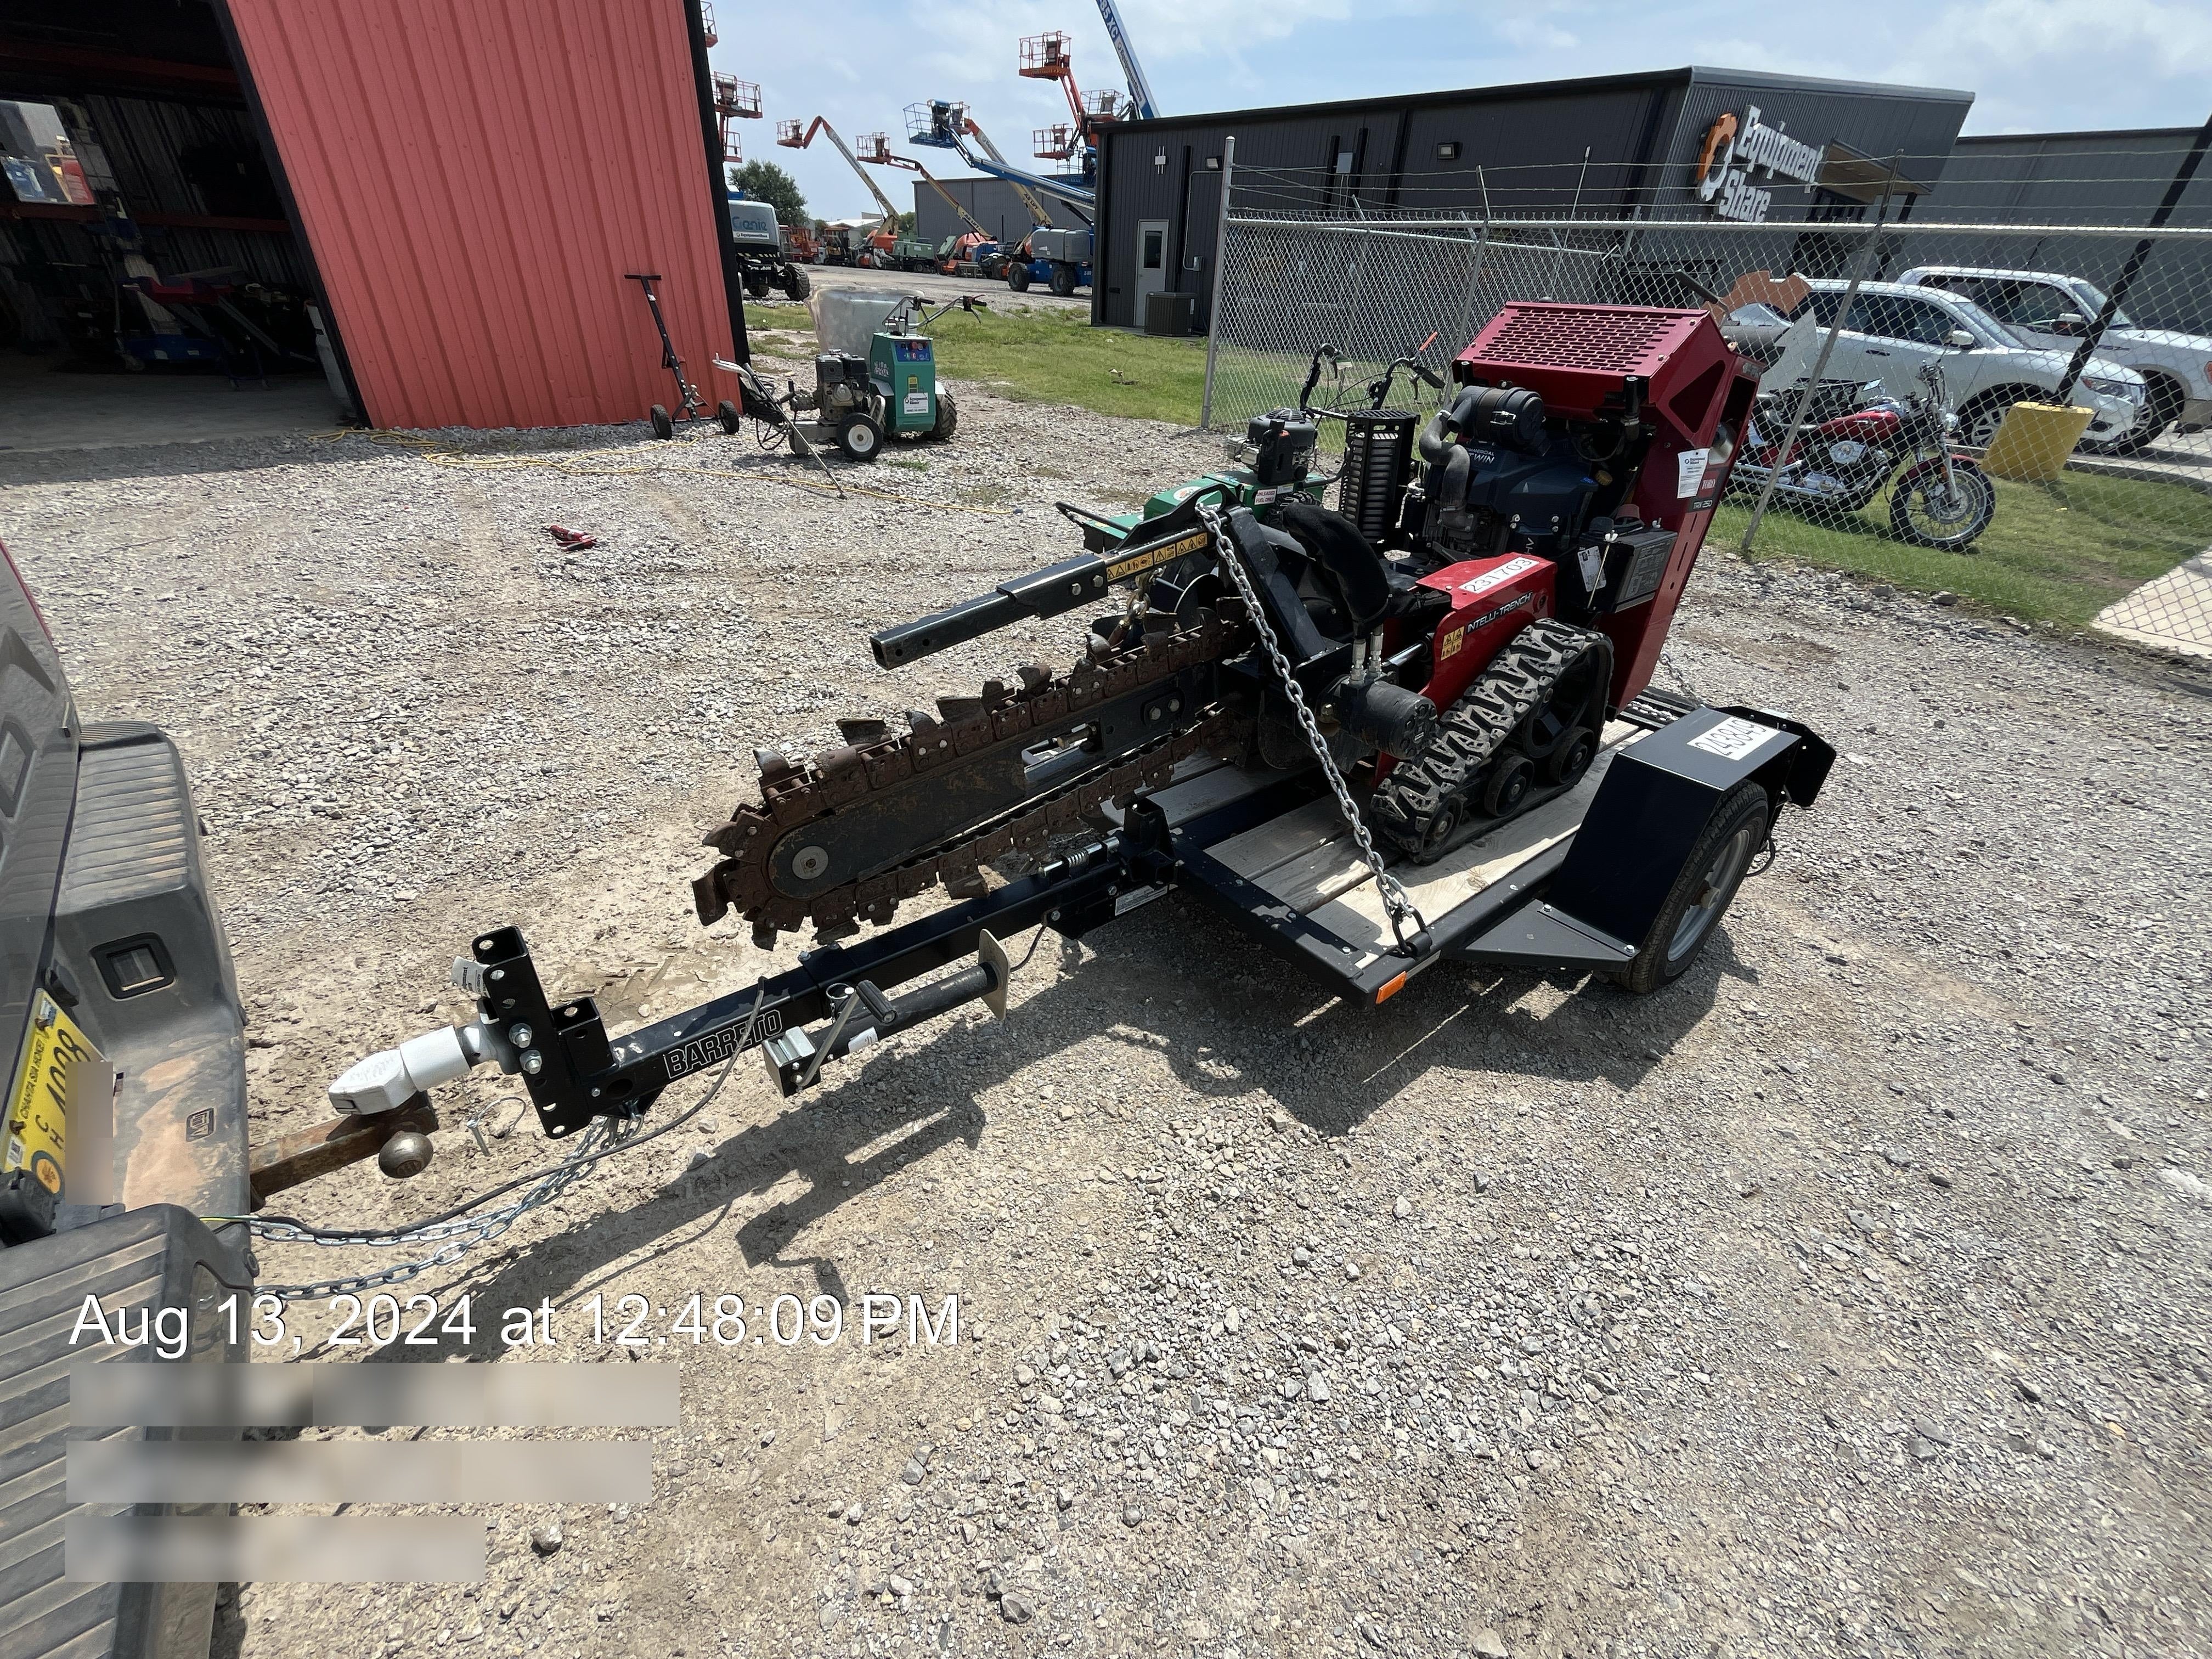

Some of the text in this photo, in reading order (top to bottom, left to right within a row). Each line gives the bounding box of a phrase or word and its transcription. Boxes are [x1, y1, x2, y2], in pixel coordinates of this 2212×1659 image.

[1736, 105, 1824, 187] Equipment
[1718, 169, 1771, 222] Share
[732, 216, 768, 230] Genie
[1464, 558, 1532, 591] 231703
[1466, 592, 1532, 633] INTELLI-TRENCH
[1695, 720, 1767, 756] 243849
[663, 1009, 783, 1079] BARRETO
